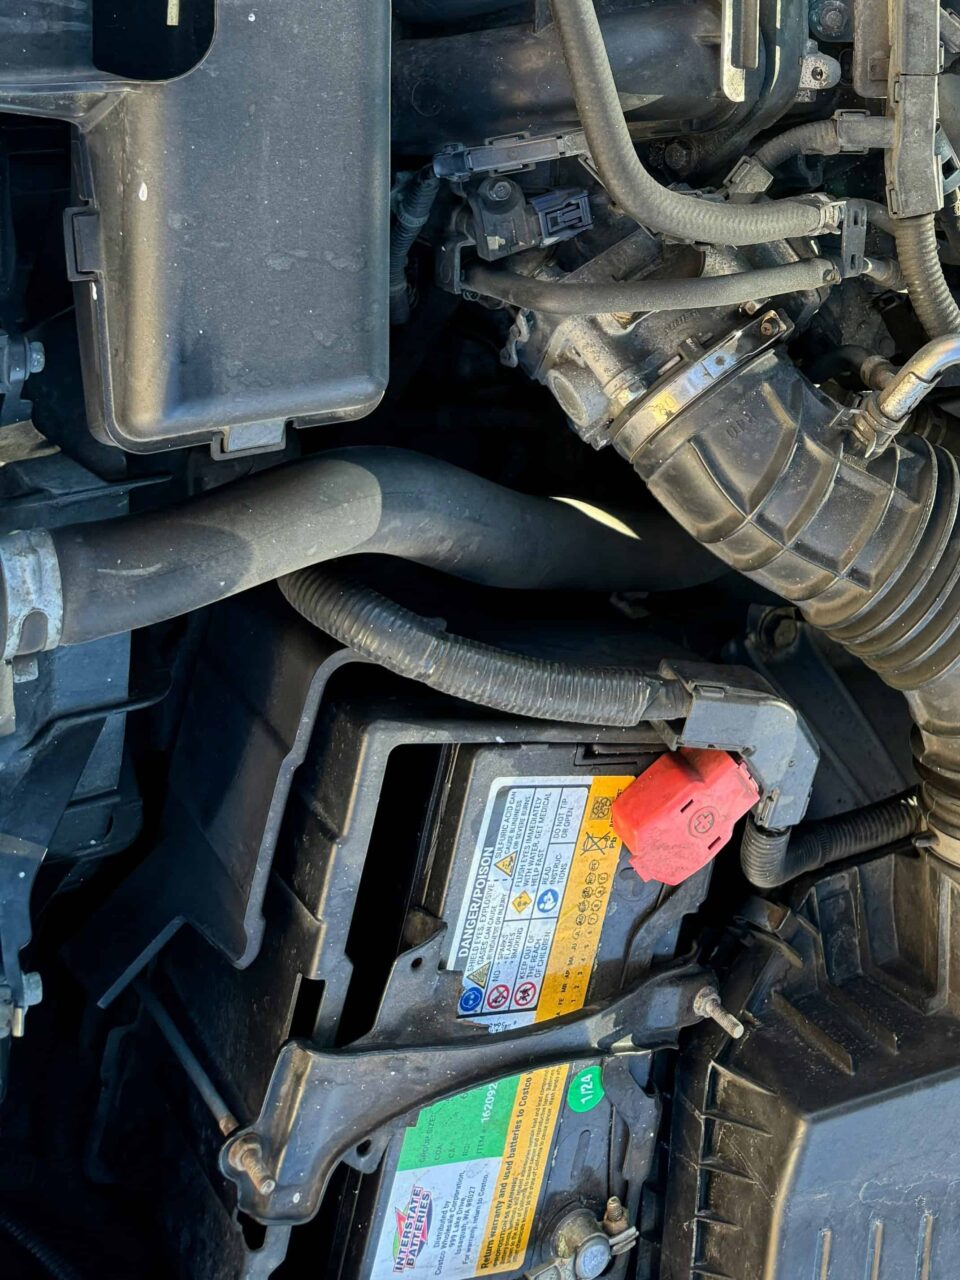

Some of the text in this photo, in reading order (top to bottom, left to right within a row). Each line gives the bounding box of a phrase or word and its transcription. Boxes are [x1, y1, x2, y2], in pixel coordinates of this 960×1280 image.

[538, 791, 551, 823] MEDICAL
[553, 798, 568, 838] DO NOT TIP
[494, 791, 516, 858] SULFURIC ACID CAN
[534, 825, 543, 838] GET
[560, 828, 568, 837] OR
[515, 797, 542, 887] FLUSH EYES IMMEDIATELY
[608, 836, 617, 848] Pb
[522, 867, 532, 886] WITH
[530, 867, 540, 886] HELP
[541, 866, 551, 884] READ
[457, 846, 494, 957] DANGER/POISON
[478, 883, 495, 922] EXPLOSIVE
[503, 932, 515, 959] FLAMES
[510, 927, 523, 958] SMOKING
[523, 945, 532, 959] OUT
[519, 961, 528, 978] KEEP
[527, 938, 541, 977] THE REACH
[492, 970, 500, 981] NO
[534, 968, 542, 977] OF
[518, 1076, 532, 1106] Costco
[580, 1074, 594, 1103] 1/24
[516, 1108, 524, 1117] to
[506, 1119, 522, 1158] batteries
[501, 1160, 513, 1180] used
[496, 1182, 507, 1198] and
[394, 1186, 422, 1271] INTERSTATE
[433, 1200, 451, 1247] Distributed by
[434, 1170, 465, 1275] Costco Wholesale Corporation,
[452, 1216, 461, 1232] Lake
[462, 1208, 470, 1220] WA
[488, 1199, 505, 1237] warranty
[405, 1191, 430, 1267] BATTERIES
[462, 1254, 470, 1264] For
[472, 1205, 481, 1223] return
[480, 1239, 494, 1269] Return
